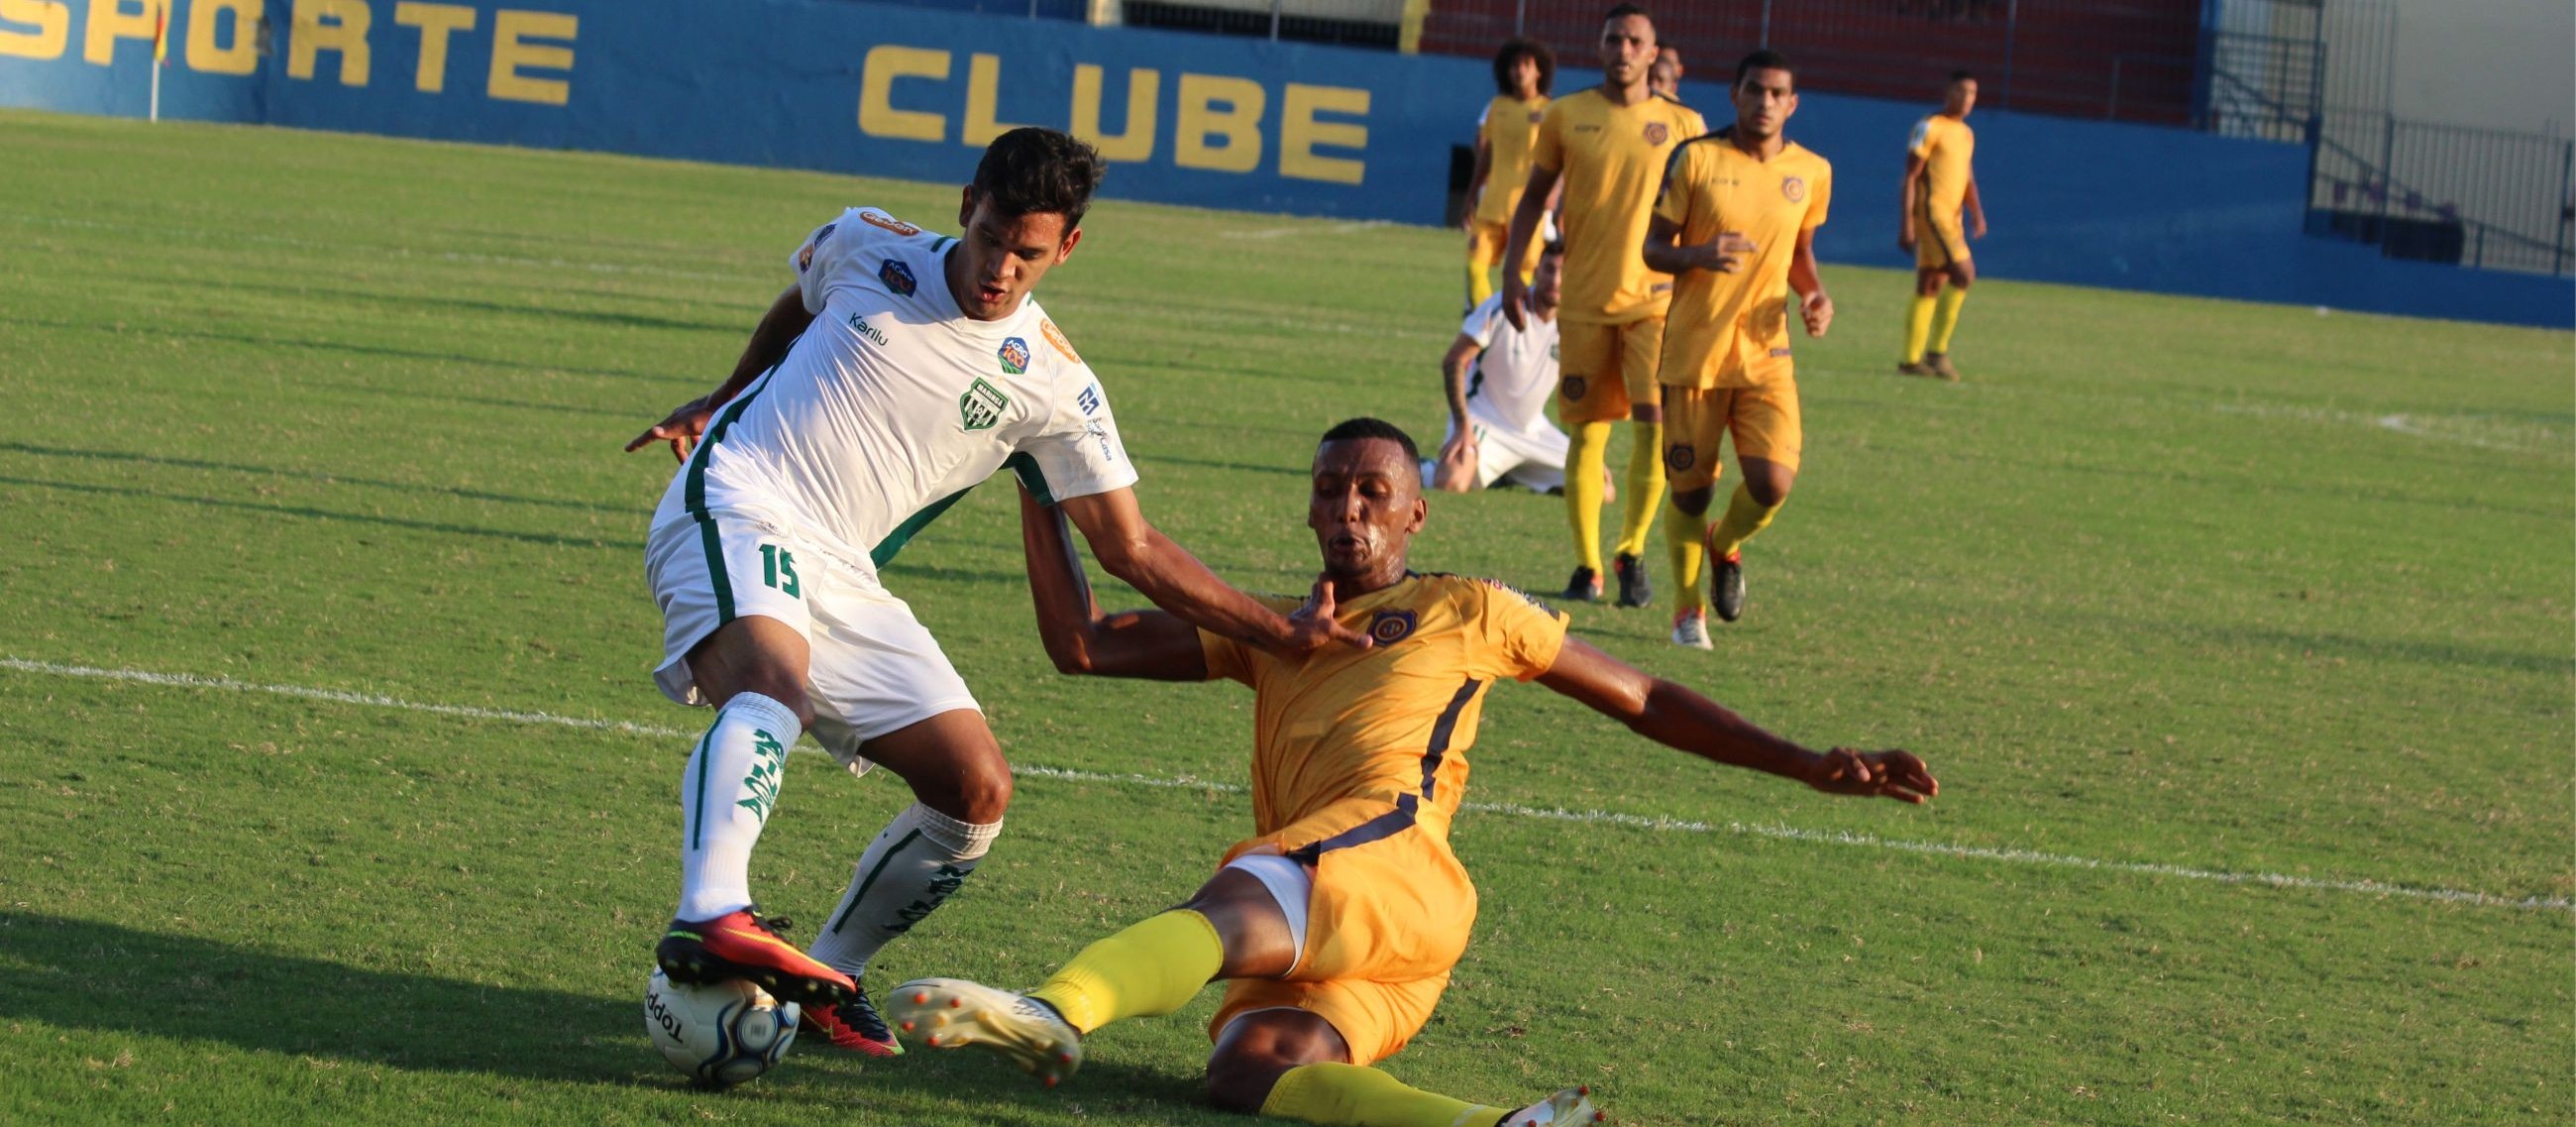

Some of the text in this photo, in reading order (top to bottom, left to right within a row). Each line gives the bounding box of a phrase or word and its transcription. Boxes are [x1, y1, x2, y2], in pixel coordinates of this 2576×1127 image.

[858, 45, 1371, 185] CLUBE
[849, 312, 889, 346] Karilu
[1007, 340, 1028, 358] AGRO
[1003, 345, 1025, 368] 100
[758, 543, 801, 600] 15
[647, 990, 684, 1044] Topp
